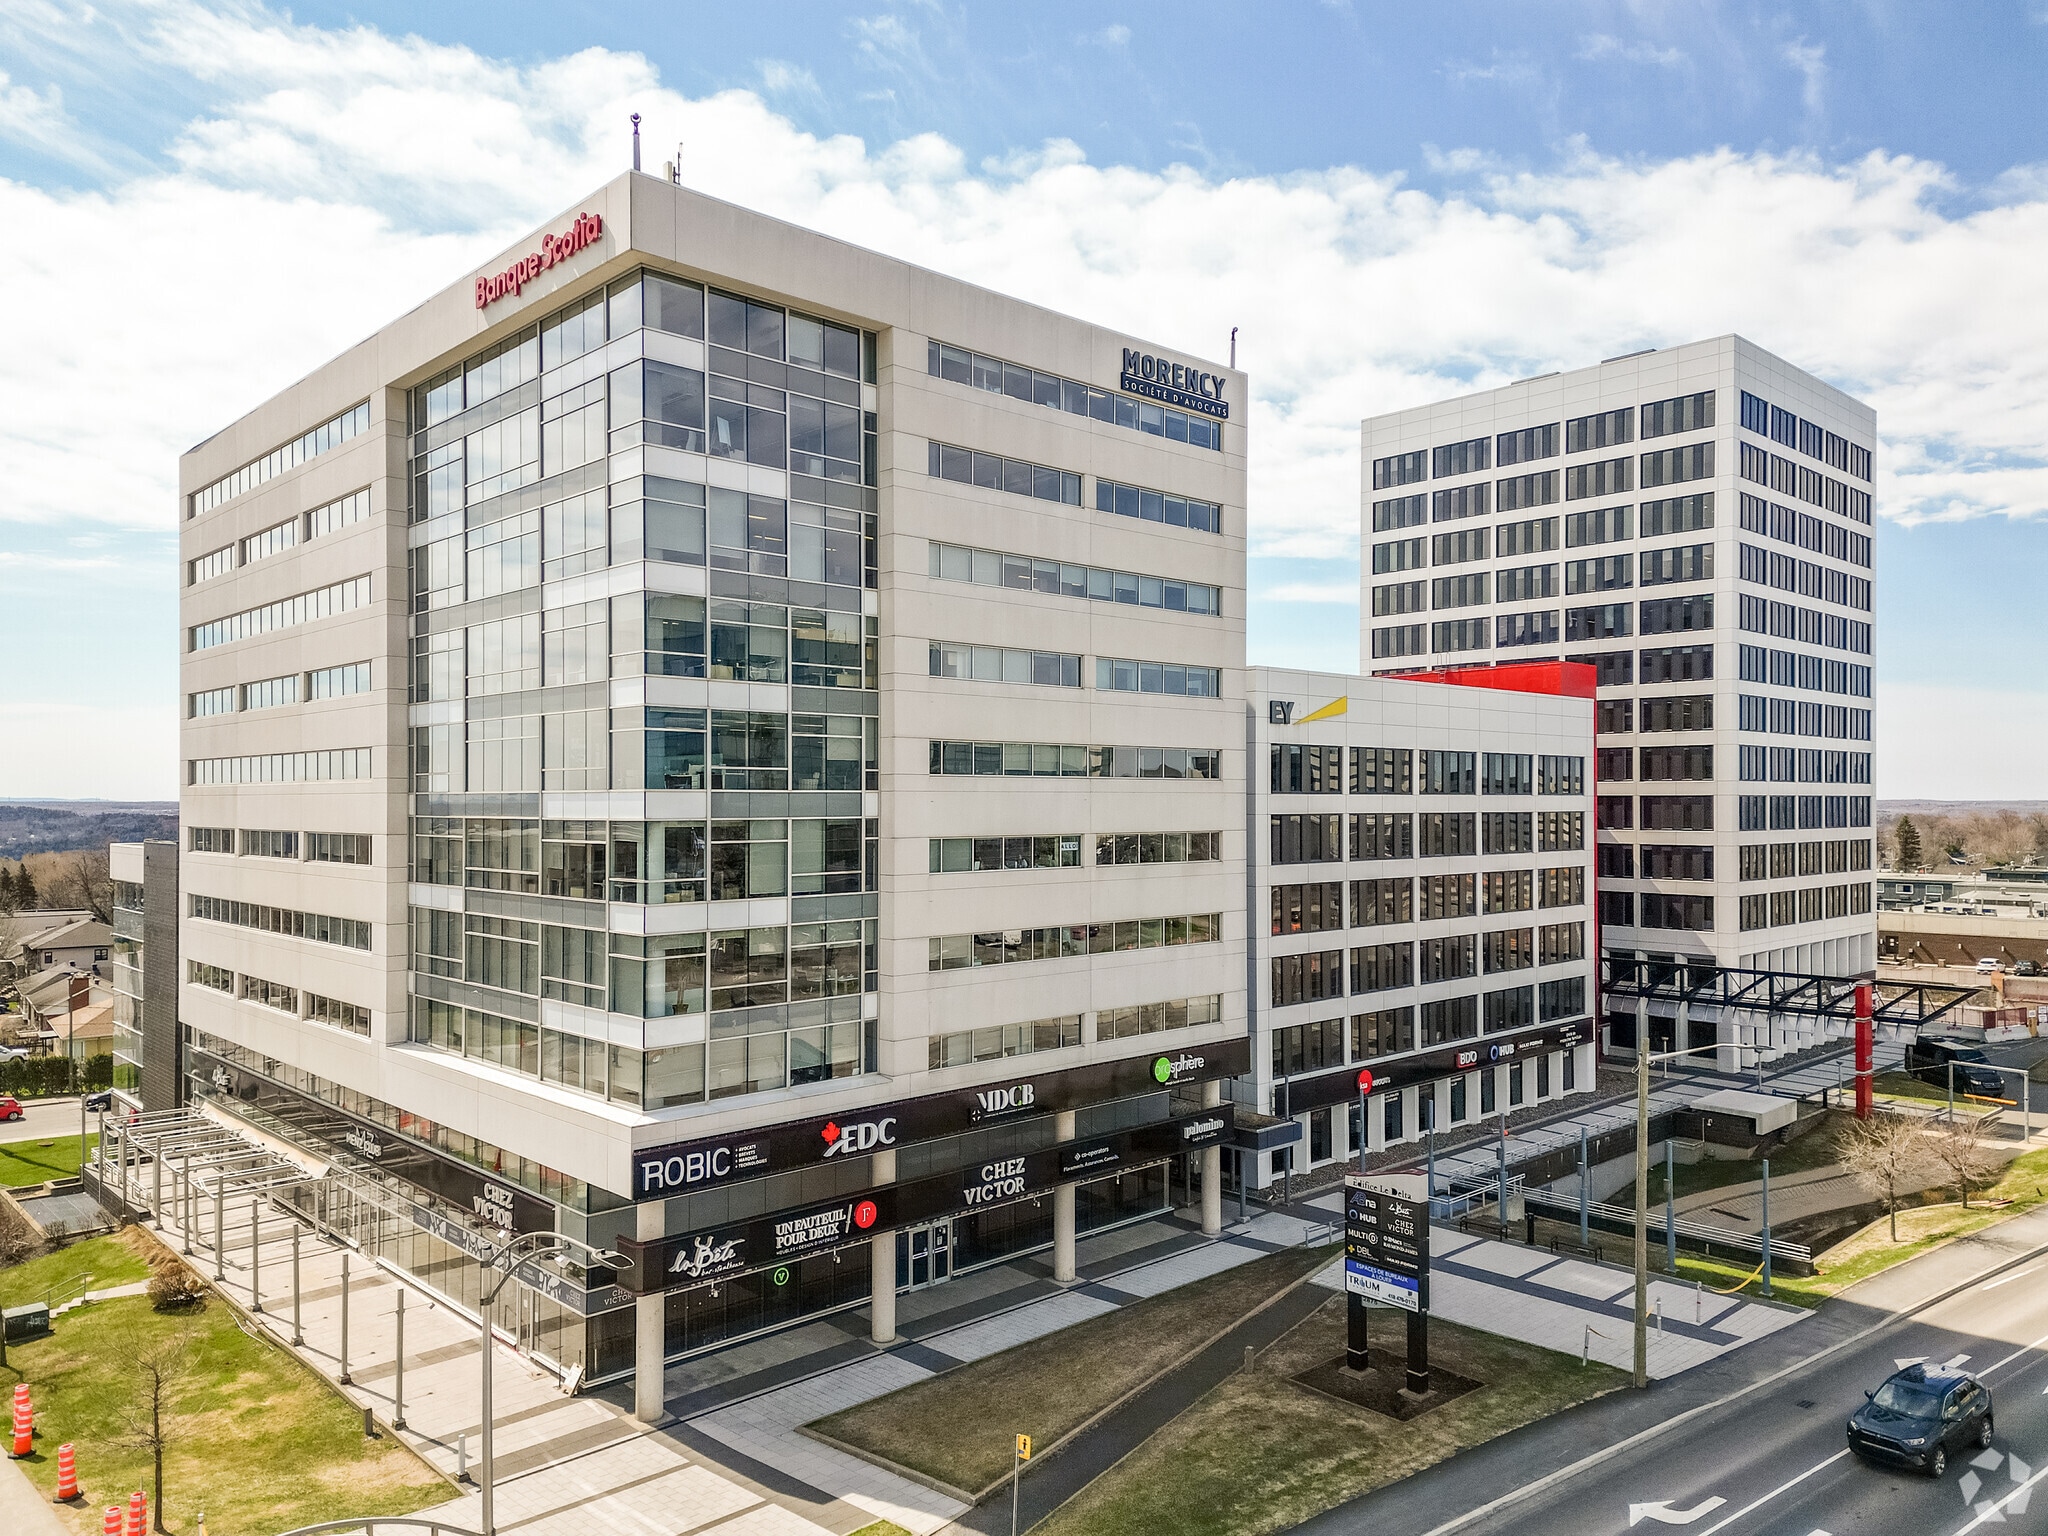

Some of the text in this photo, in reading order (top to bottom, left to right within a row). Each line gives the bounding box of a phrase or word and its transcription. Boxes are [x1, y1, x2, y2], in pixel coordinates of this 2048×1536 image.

[476, 212, 602, 310] Banque Scotia
[1122, 348, 1226, 399] MORENCY
[1124, 380, 1227, 416] SOCIÉTÉ D'AVOCATS
[1270, 700, 1294, 724] EY
[1460, 1050, 1478, 1064] BDO
[1499, 1044, 1514, 1056] HUB
[976, 1084, 1034, 1112] VDCB
[836, 1117, 897, 1155] EDC
[1184, 1118, 1224, 1139] palomino
[738, 1144, 756, 1152] AVOCATS
[1081, 1147, 1109, 1158] co-operators
[642, 1148, 730, 1192] ROBIC
[980, 1156, 1026, 1182] CHEZ
[484, 1182, 514, 1209] CHEZ
[964, 1176, 1026, 1206] VICTOR
[1353, 1177, 1412, 1200] Édifice Le Delta
[473, 1196, 513, 1230] VICTOR
[775, 1209, 846, 1236] UN FAUTEUIL
[862, 1207, 871, 1222] F
[1360, 1213, 1377, 1224] HUB
[1395, 1220, 1414, 1230] CHEZ
[776, 1222, 839, 1249] POUR DEUX
[1388, 1224, 1414, 1237] VICTOR
[687, 1236, 746, 1277] Bête
[1357, 1246, 1372, 1256] DBL
[1356, 1263, 1408, 1283] ESPACES DE BUREAUX
[1376, 1275, 1392, 1283] LOUER
